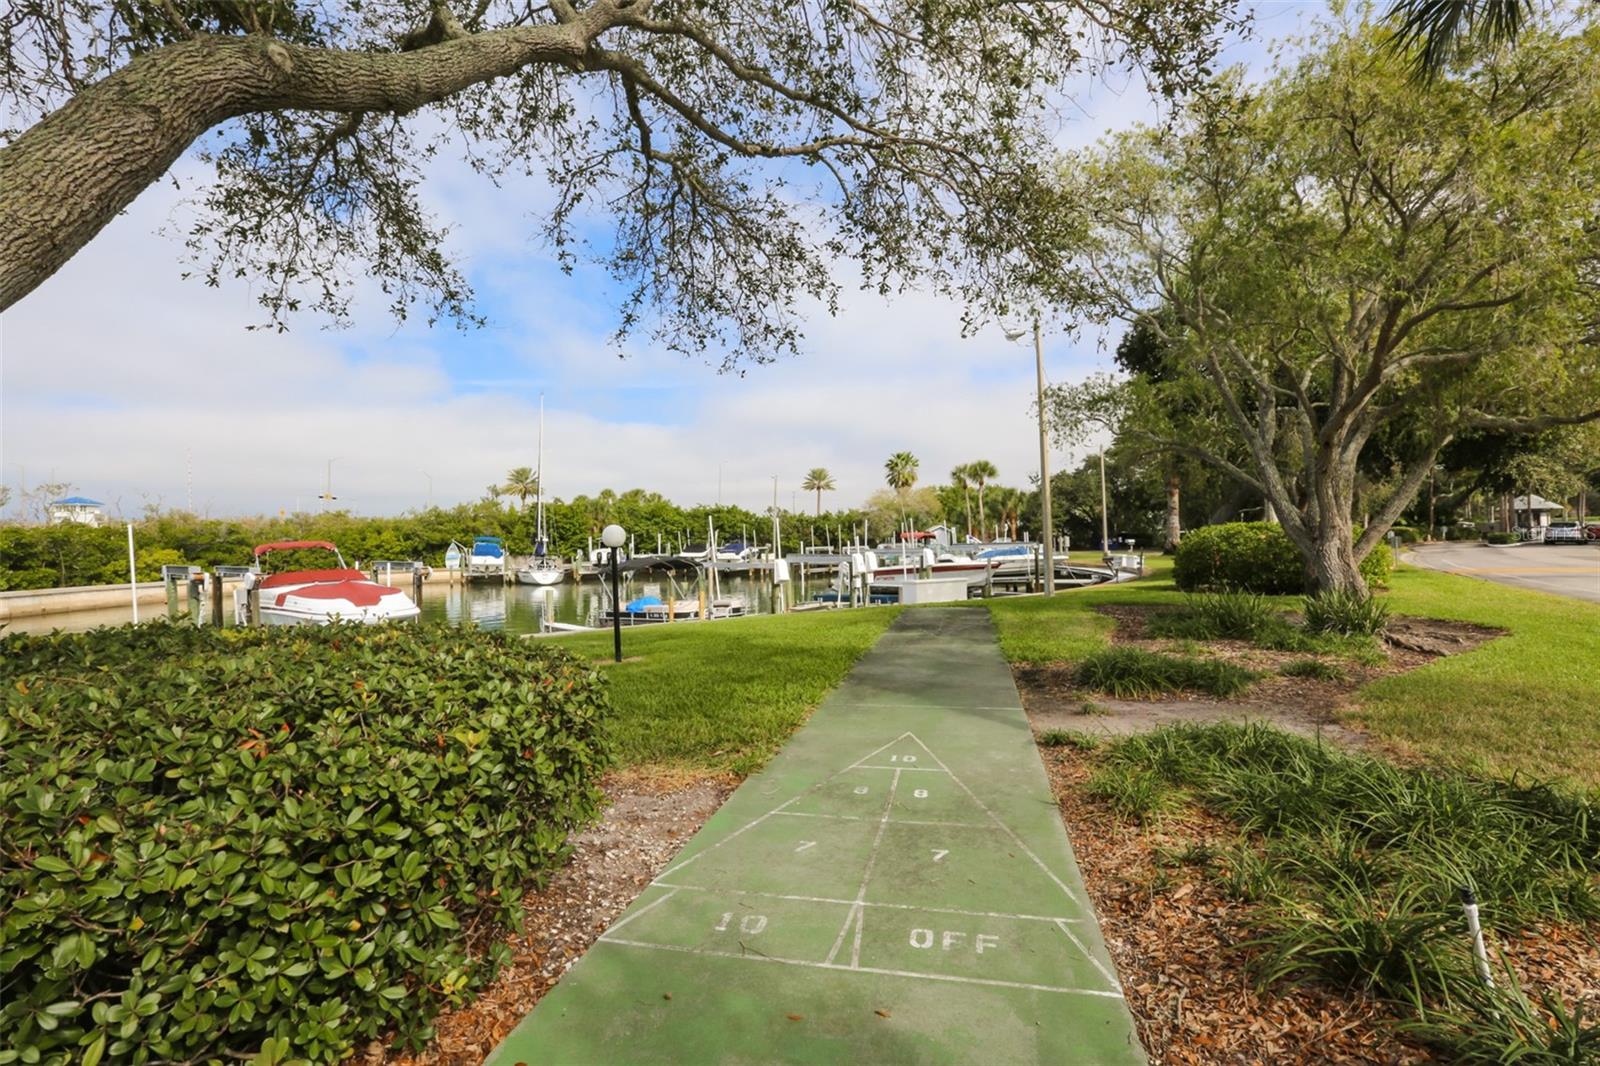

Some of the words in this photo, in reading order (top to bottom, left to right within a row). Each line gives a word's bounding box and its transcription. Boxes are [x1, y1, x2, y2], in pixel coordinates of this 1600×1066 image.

[914, 789, 928, 798] 8
[795, 840, 816, 852] 7
[930, 849, 949, 861] 7
[715, 912, 768, 934] 10
[909, 928, 1000, 953] OFF
